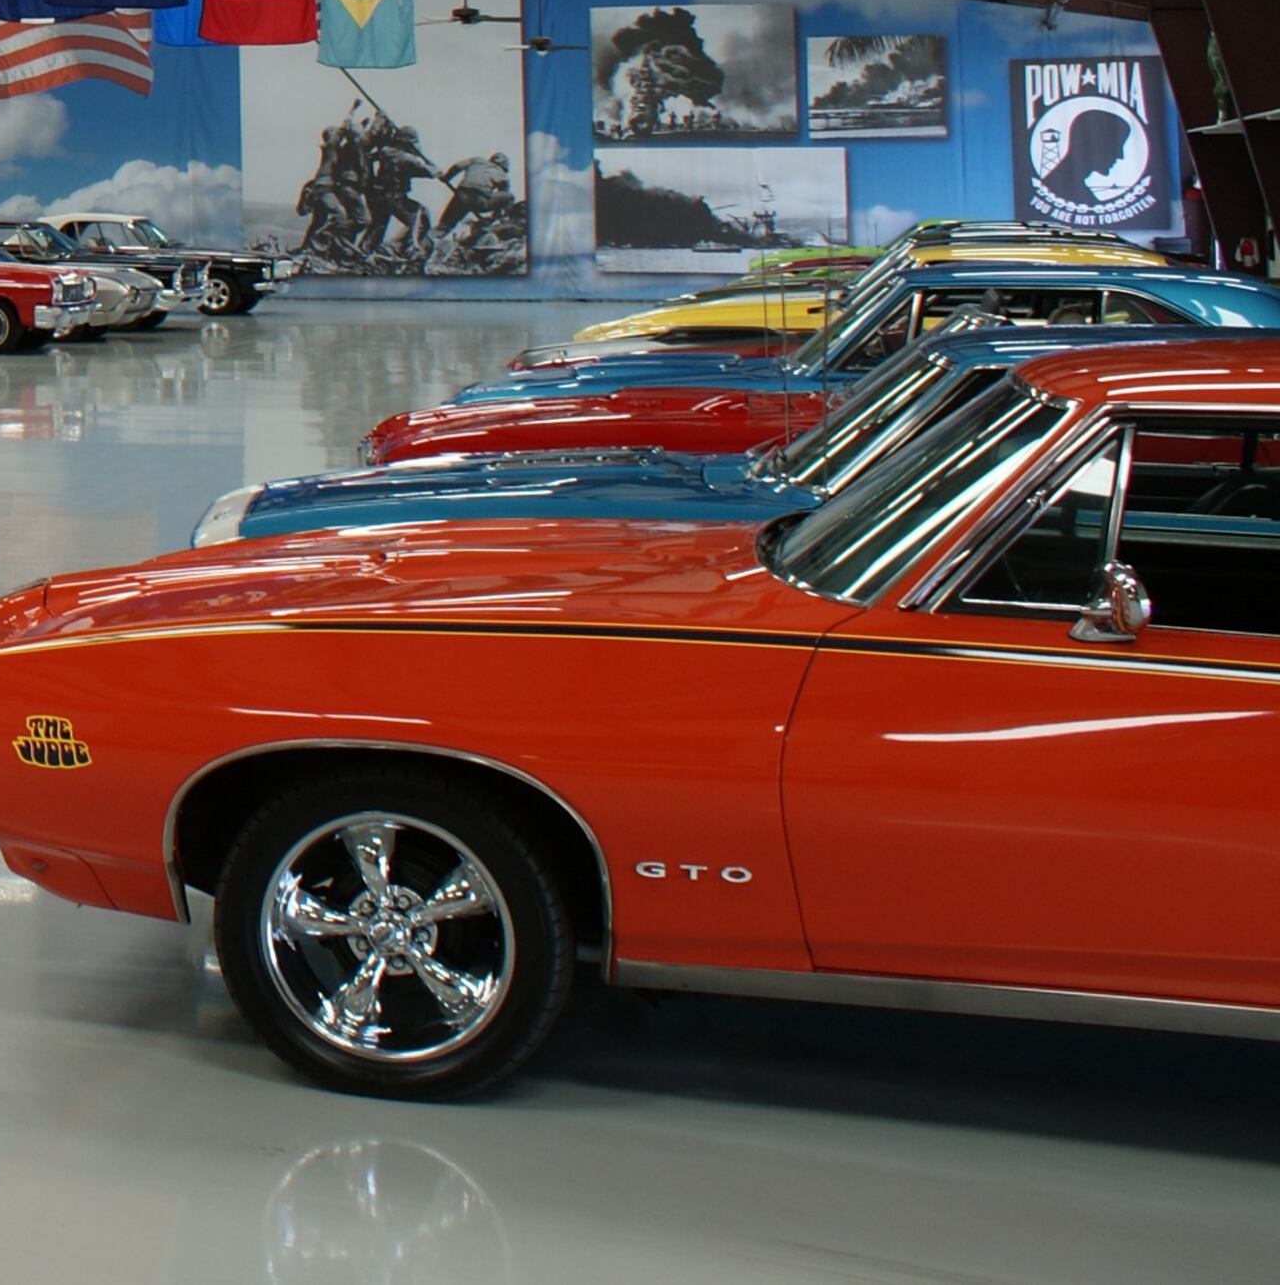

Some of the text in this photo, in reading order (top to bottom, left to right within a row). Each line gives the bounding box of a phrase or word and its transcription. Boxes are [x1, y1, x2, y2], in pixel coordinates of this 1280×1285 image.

[1025, 61, 1149, 130] POW MIA
[1029, 194, 1157, 226] YOU ARE NOT FORGOTTEN
[26, 715, 73, 741] THE
[12, 737, 92, 769] JUDGE
[635, 861, 753, 884] GTO
